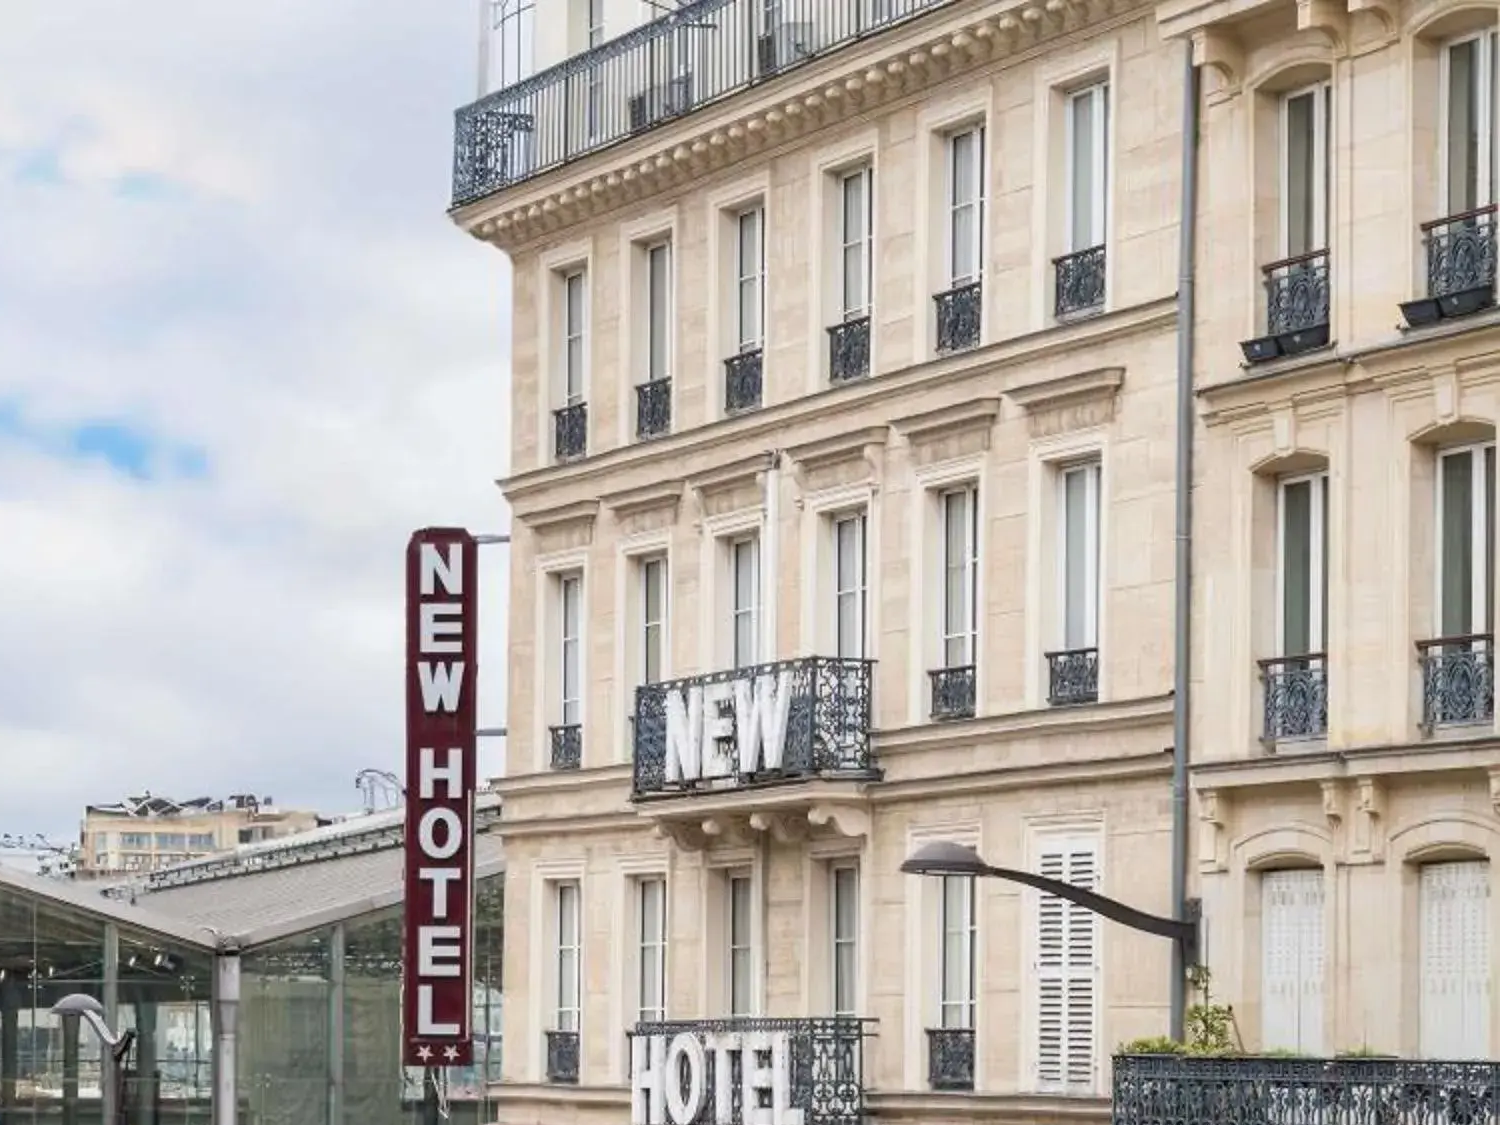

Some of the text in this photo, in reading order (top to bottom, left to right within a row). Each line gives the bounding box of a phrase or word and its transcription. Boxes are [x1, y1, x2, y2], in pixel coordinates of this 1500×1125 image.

[416, 543, 464, 1036] NEW HOTEL
[664, 671, 792, 782] NEW
